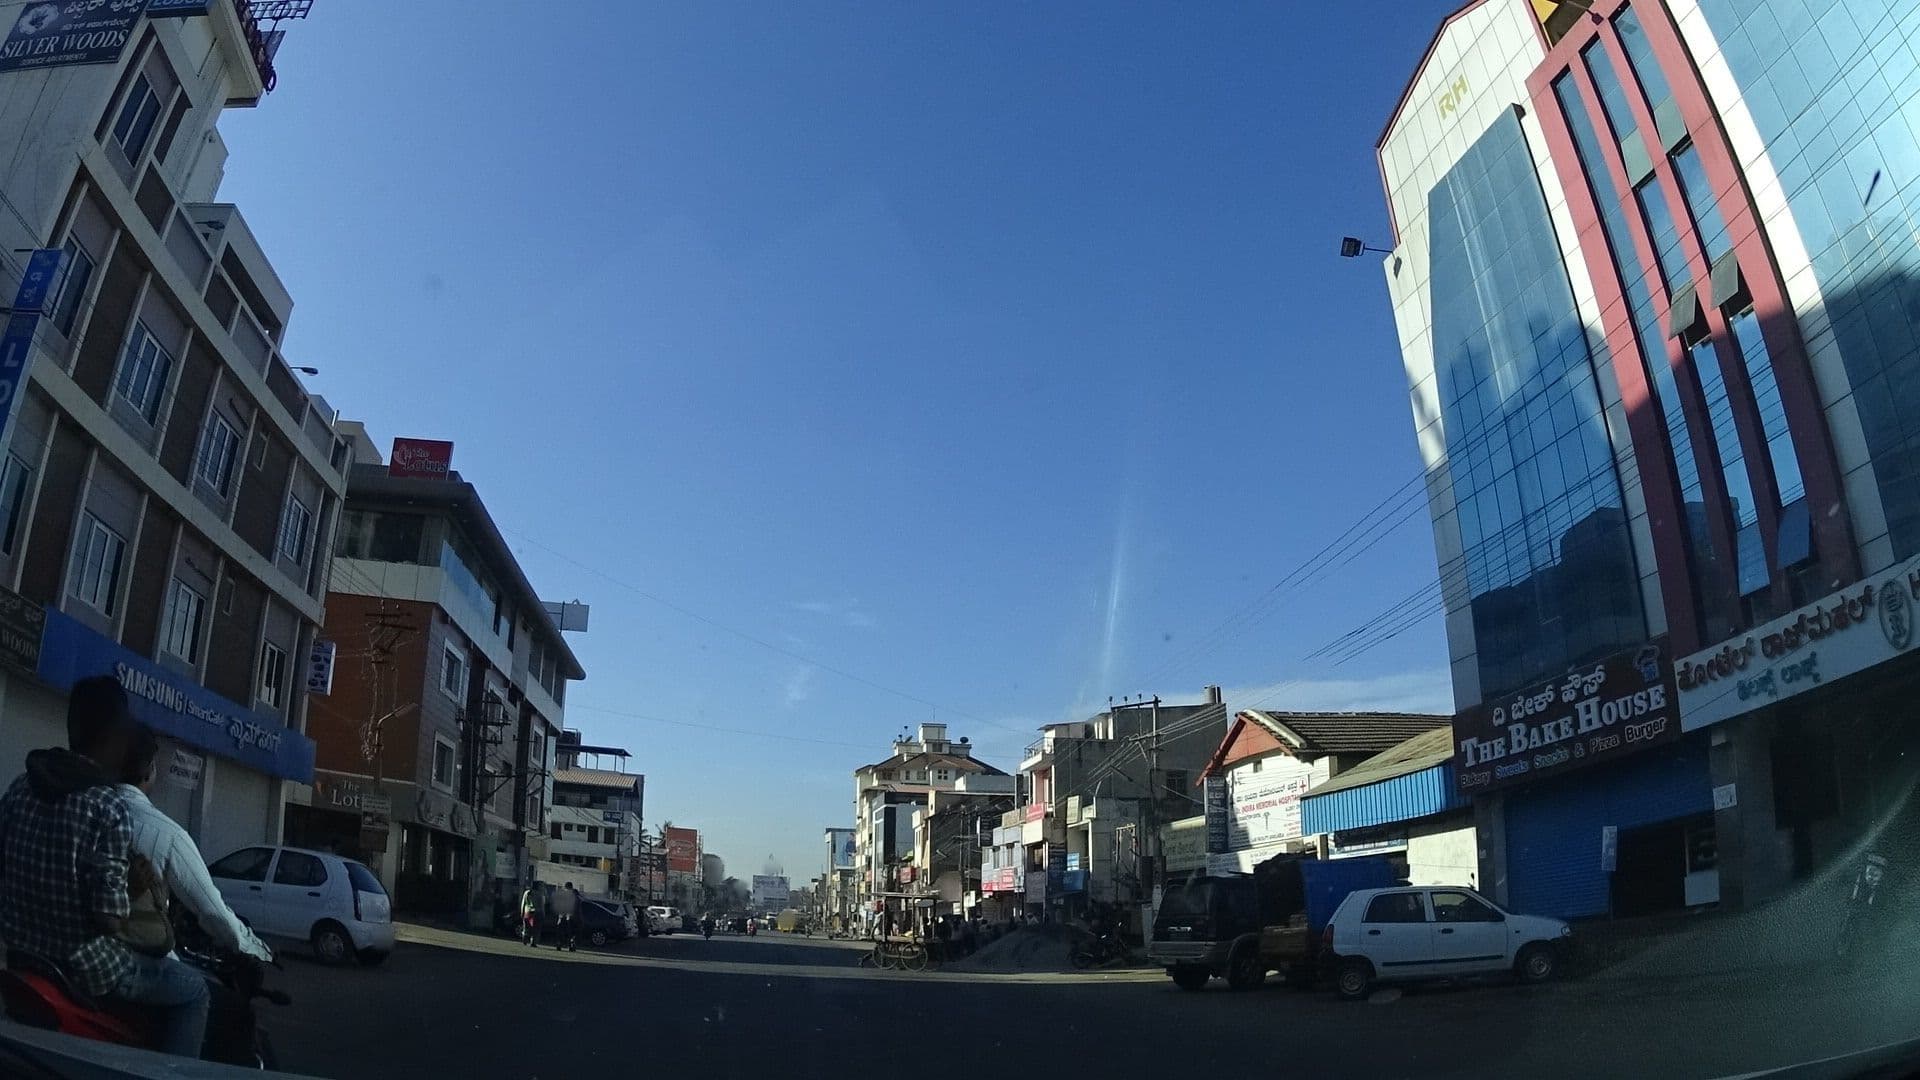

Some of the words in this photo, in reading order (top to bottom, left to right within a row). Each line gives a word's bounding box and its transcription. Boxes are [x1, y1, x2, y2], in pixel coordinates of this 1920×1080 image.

[0, 36, 59, 58] SILVER
[62, 29, 129, 50] WOODS
[1438, 73, 1468, 120] RH
[116, 662, 184, 712] SAMSUNG
[1507, 715, 1574, 755] BAKE
[1574, 684, 1667, 735] HOUSE
[1460, 771, 1490, 788] Bakery
[1495, 760, 1529, 780] Sweets
[1533, 749, 1569, 769] Snacks
[1574, 742, 1585, 759] &
[1590, 734, 1620, 754] Pizza
[1625, 716, 1666, 744] Burger
[331, 788, 361, 808] Lot
[343, 778, 360, 791] The
